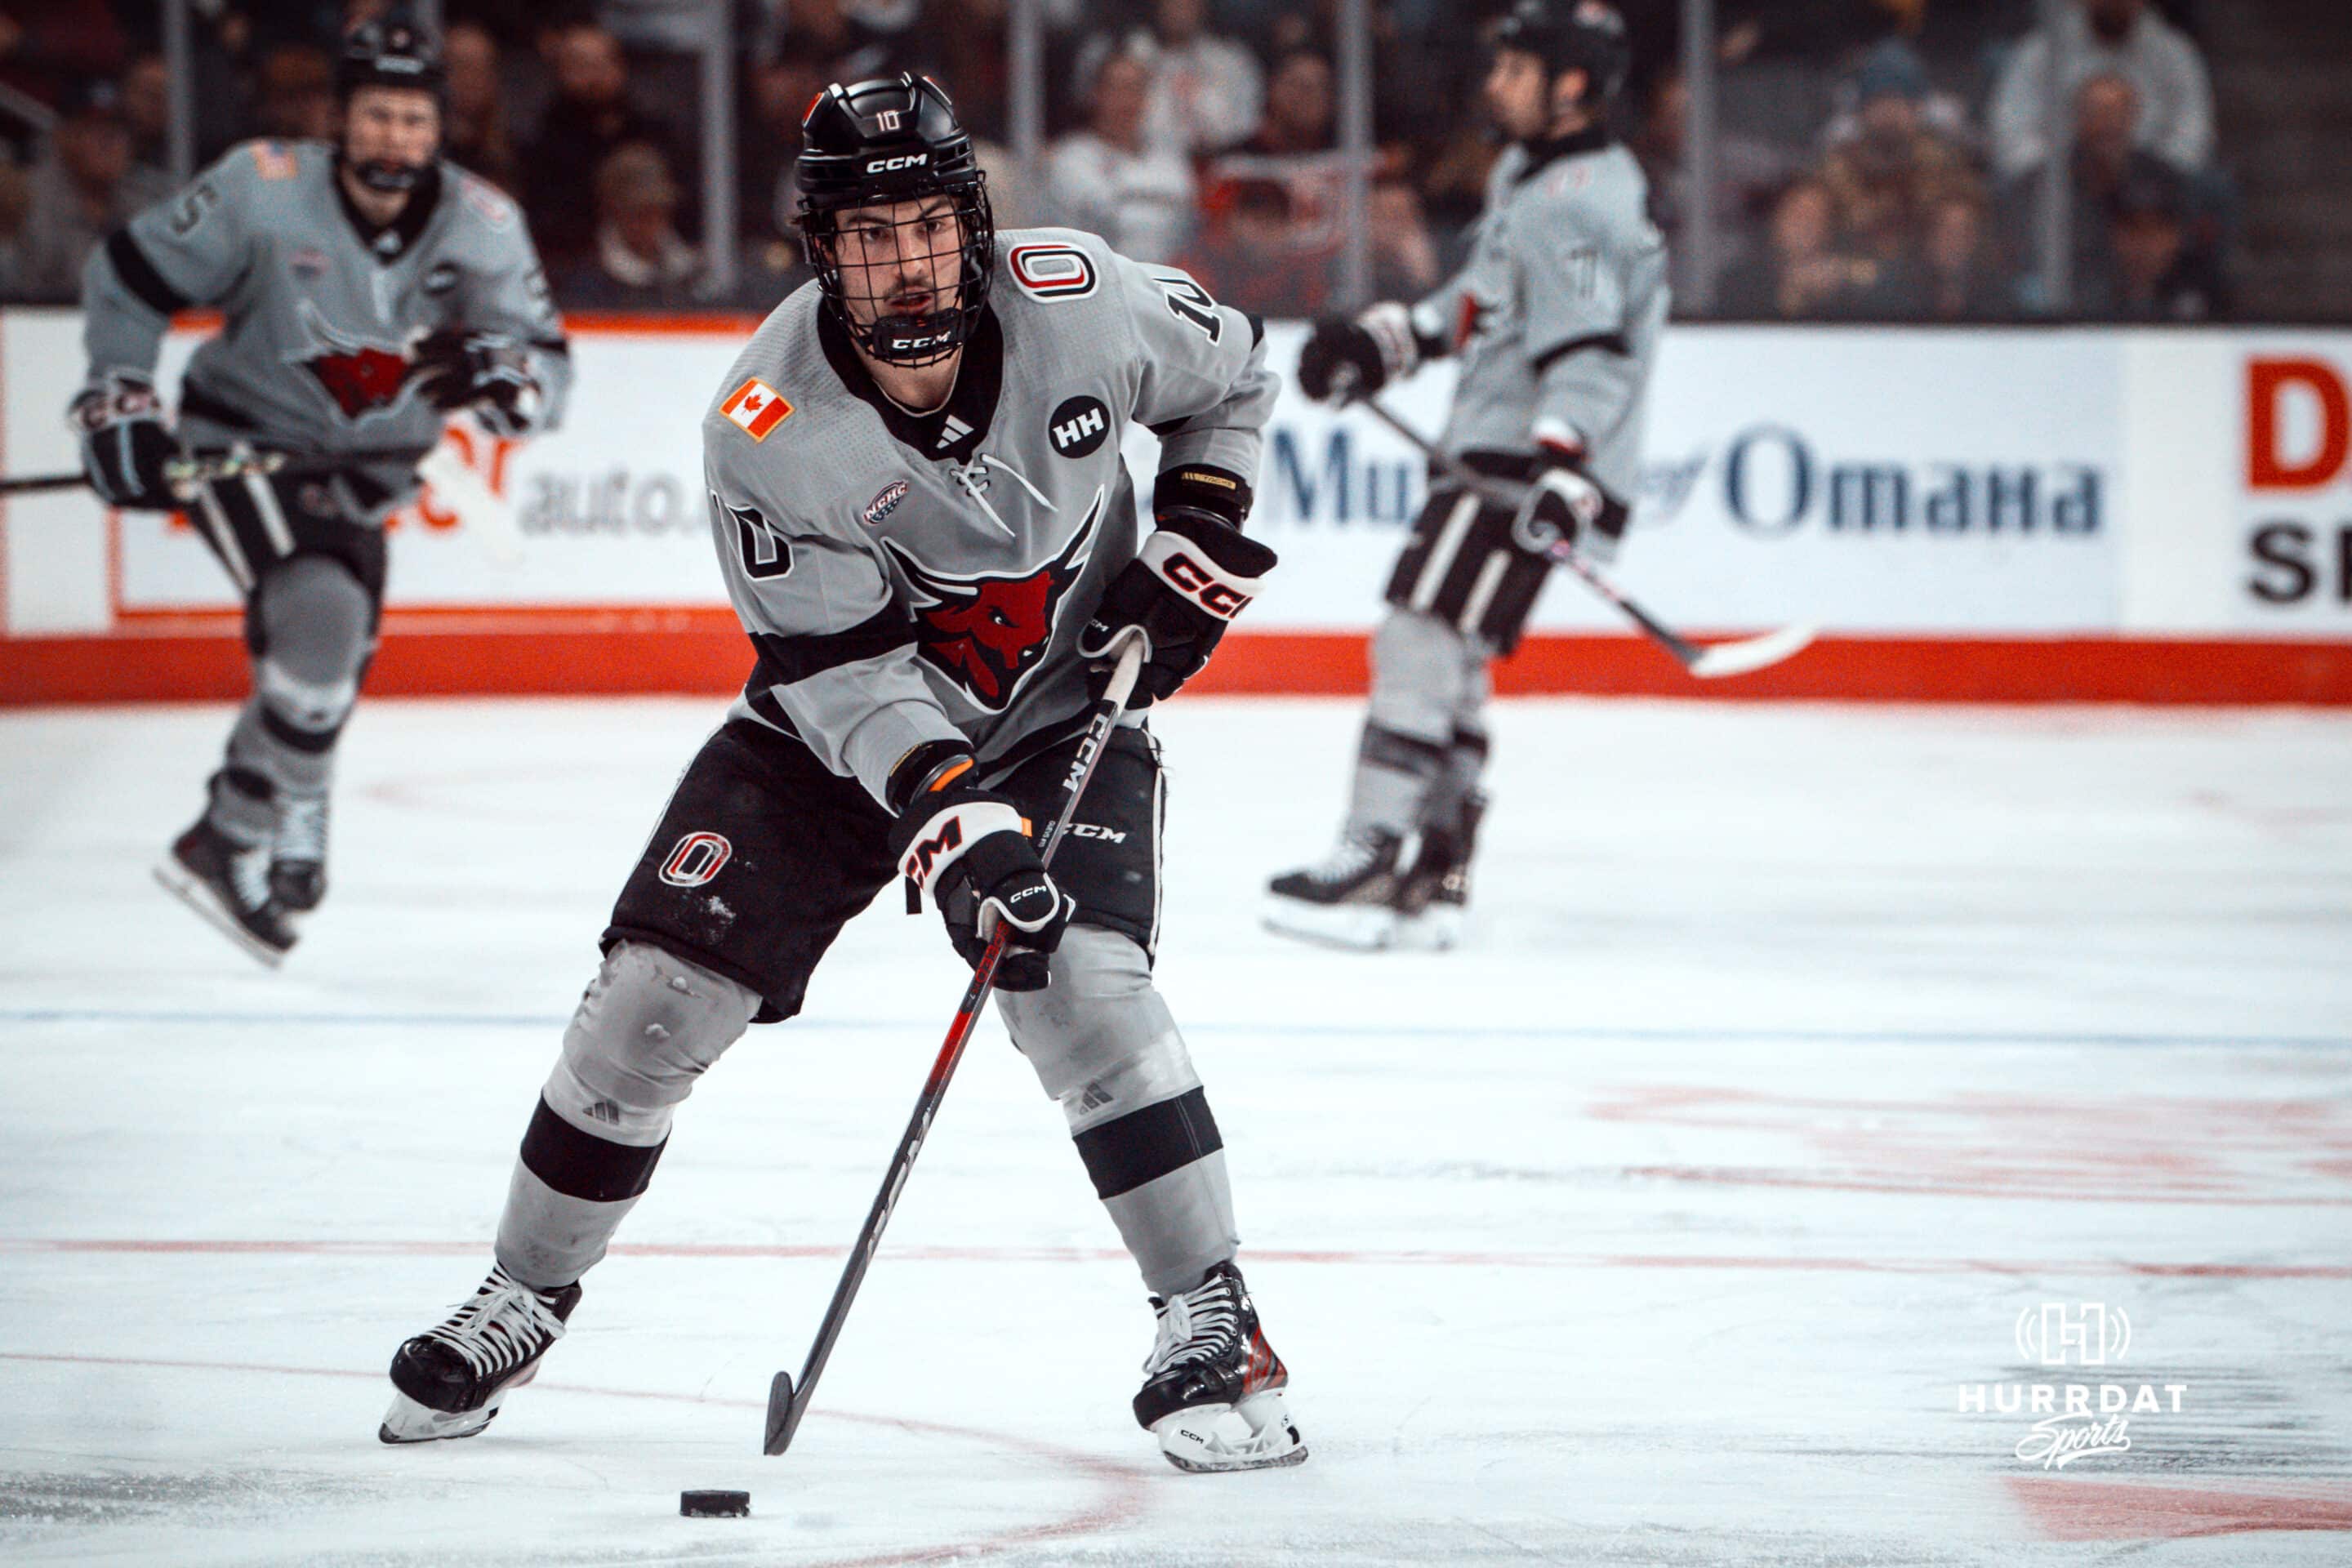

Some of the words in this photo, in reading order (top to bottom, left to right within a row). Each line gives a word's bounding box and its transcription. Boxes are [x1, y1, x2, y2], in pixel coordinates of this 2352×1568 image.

[876, 109, 901, 132] 10
[866, 153, 929, 175] CCM
[891, 330, 953, 350] CCM
[1052, 408, 1105, 449] HH
[1162, 552, 1254, 620] CC
[1062, 711, 1111, 794] CCM
[1009, 884, 1047, 904] CCM
[1179, 1429, 1205, 1445] CCM
